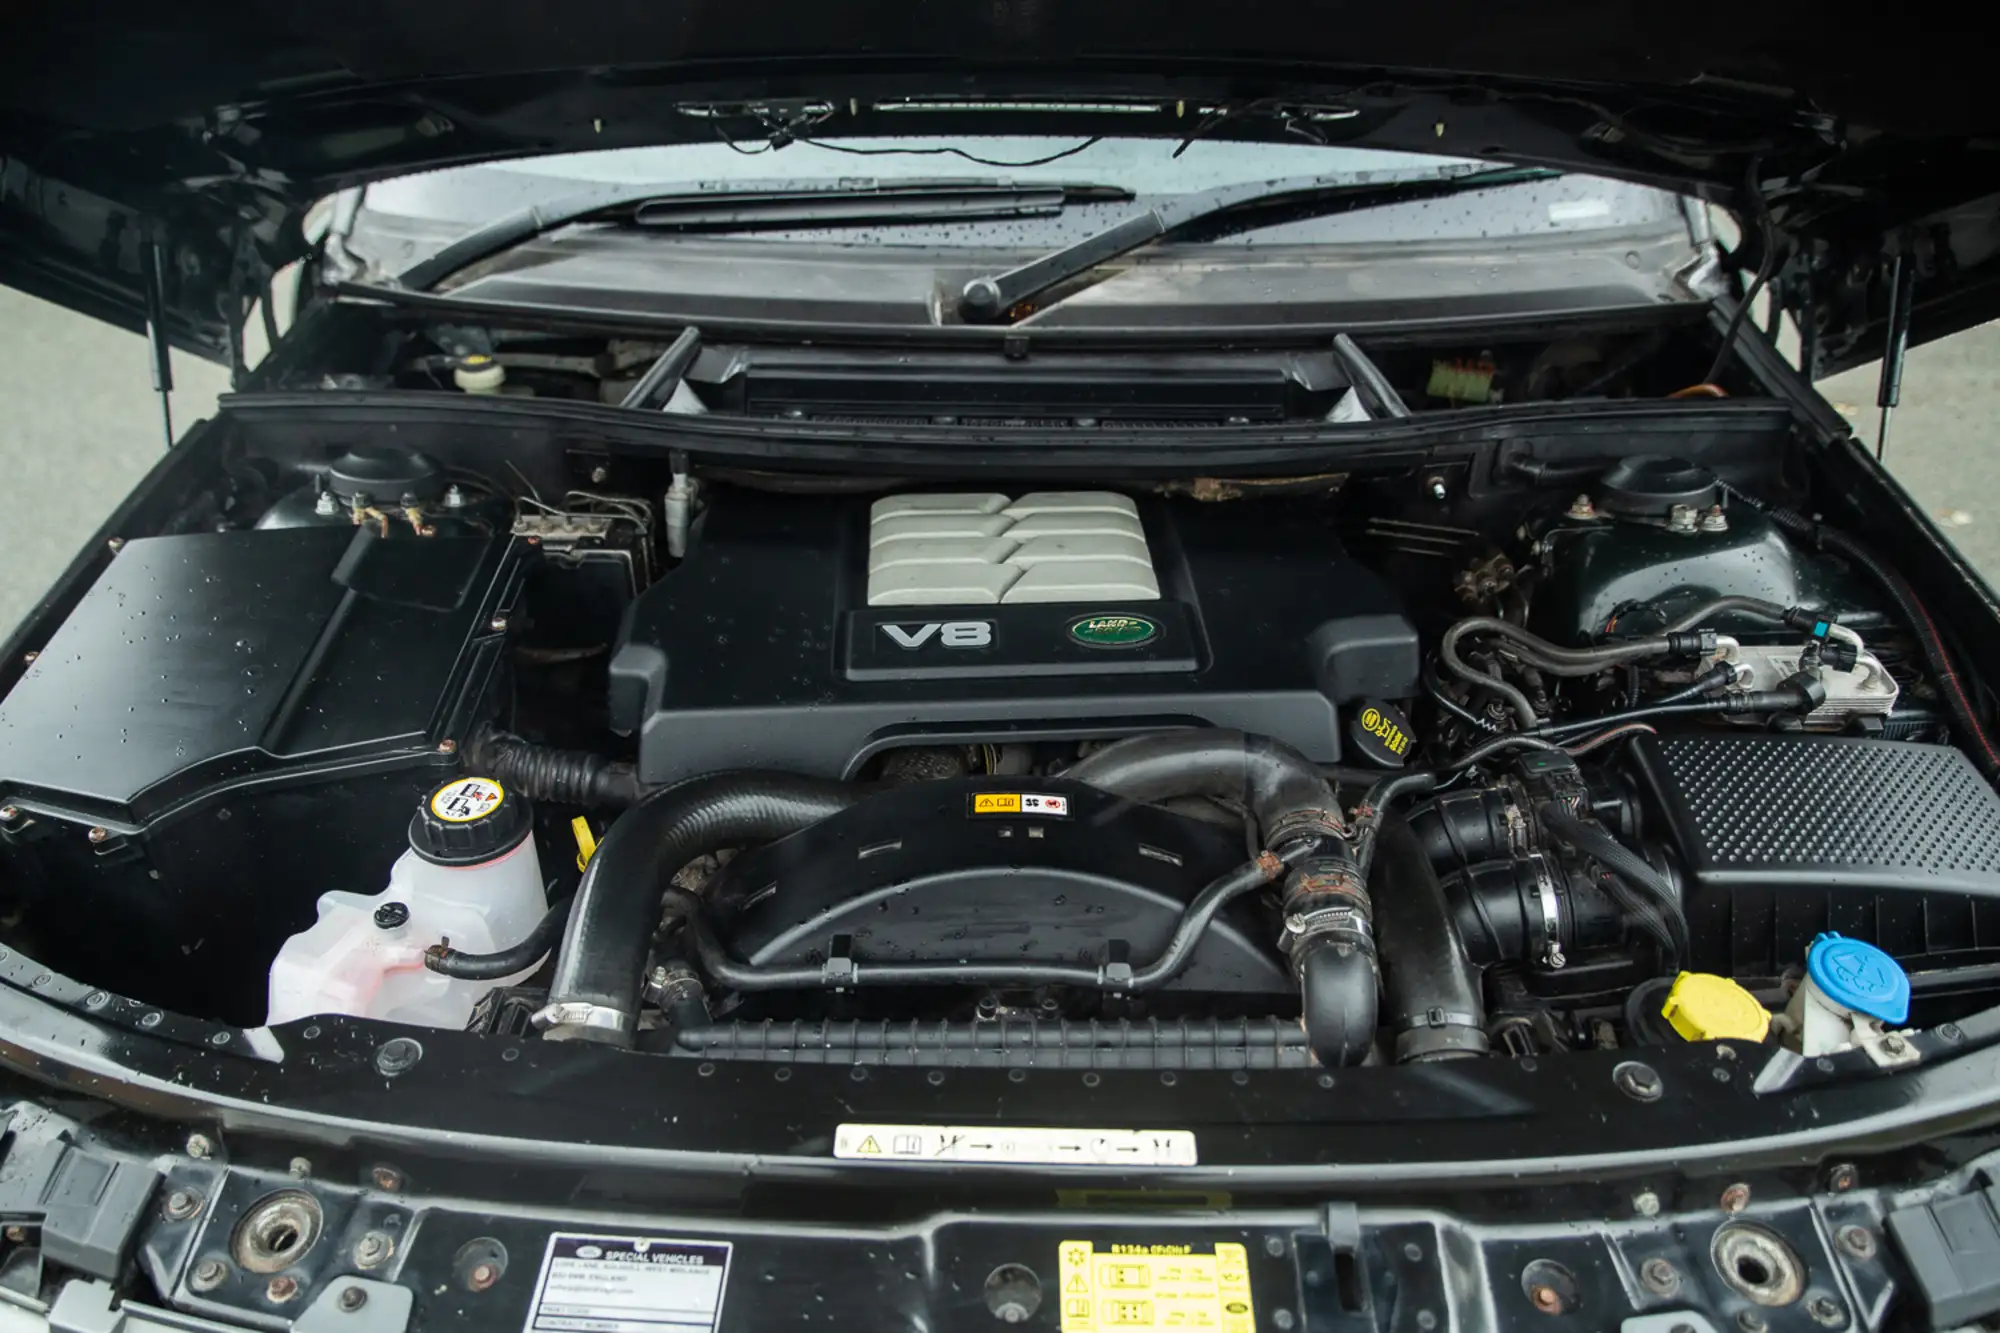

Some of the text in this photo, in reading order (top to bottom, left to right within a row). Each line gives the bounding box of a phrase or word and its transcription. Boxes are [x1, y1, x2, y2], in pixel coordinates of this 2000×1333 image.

[880, 621, 992, 648] V8
[605, 1251, 650, 1263] SPECIAL
[652, 1253, 704, 1265] VEHICLES
